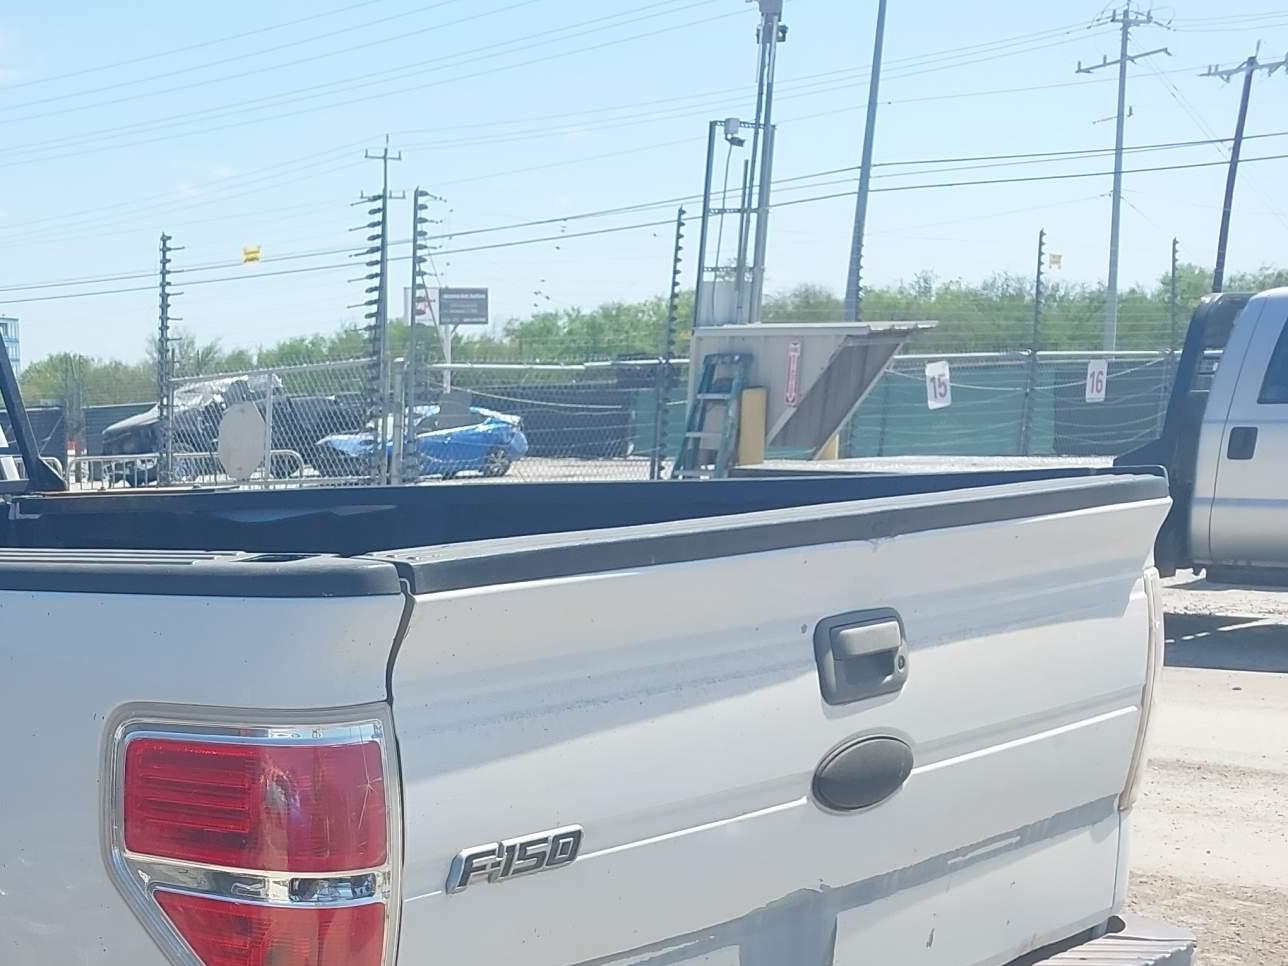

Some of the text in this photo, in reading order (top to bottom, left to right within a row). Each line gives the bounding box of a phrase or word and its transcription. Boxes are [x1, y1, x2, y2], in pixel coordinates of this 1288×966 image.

[930, 375, 950, 399] 15
[1090, 371, 1105, 394] 16
[445, 823, 583, 895] F-150
